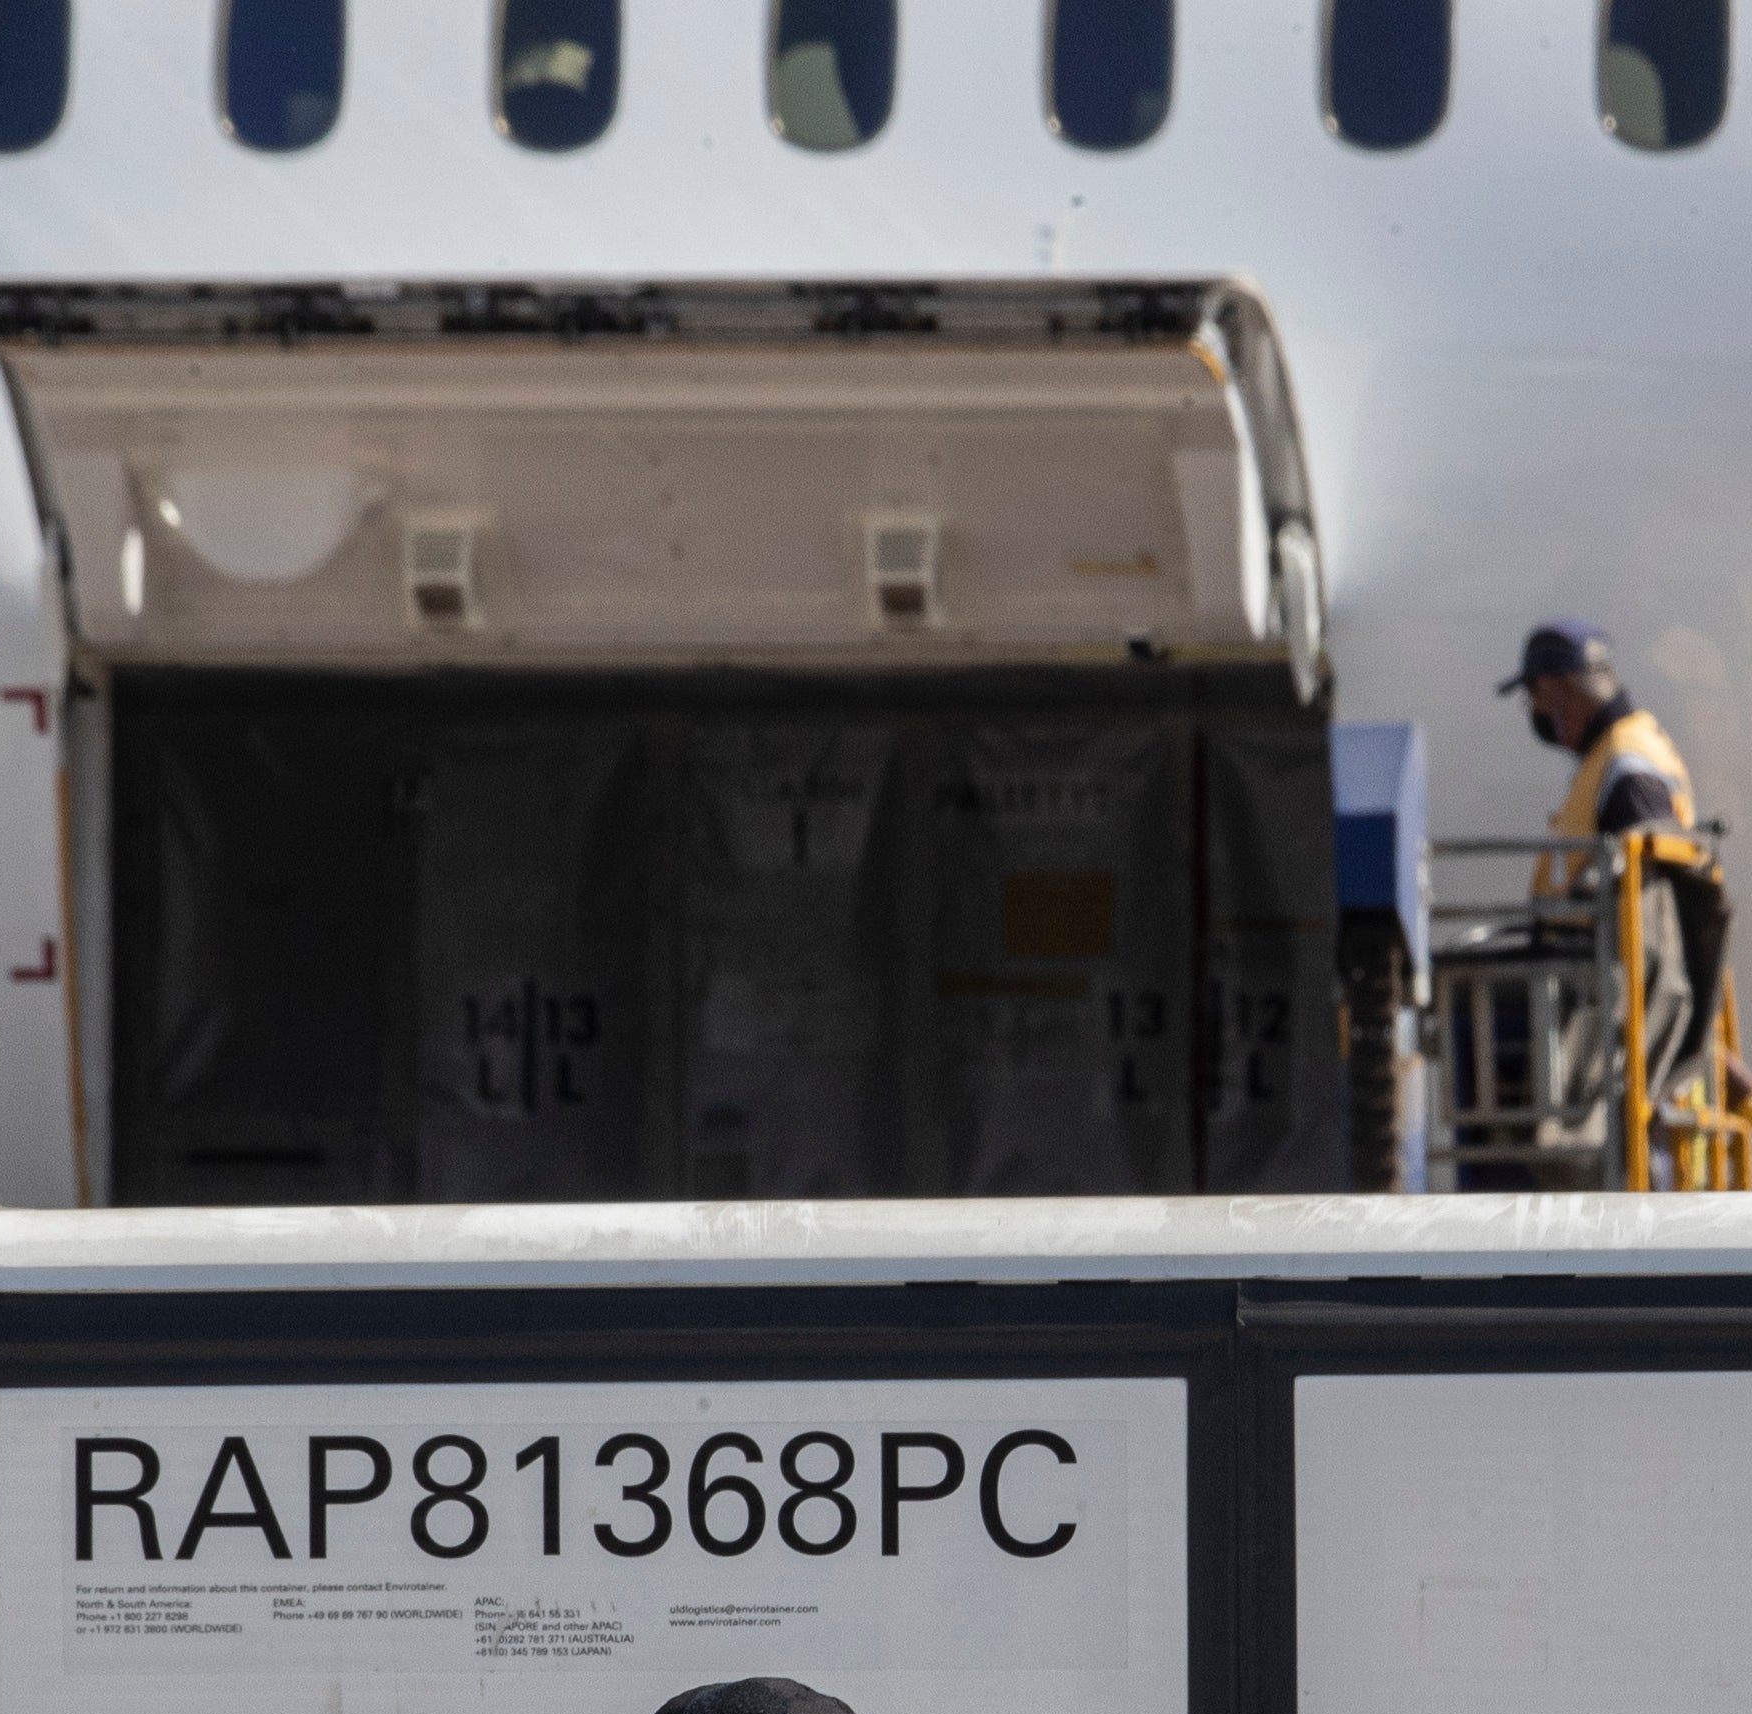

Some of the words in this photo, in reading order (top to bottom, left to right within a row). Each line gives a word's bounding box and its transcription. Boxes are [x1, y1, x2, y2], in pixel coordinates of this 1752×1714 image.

[543, 993, 602, 1046] 13
[1107, 990, 1166, 1040] 13
[72, 1429, 1078, 1562] RAP81368PC
[127, 1585, 146, 1593] and
[150, 1584, 206, 1594] information
[209, 1584, 237, 1593] about
[76, 1600, 103, 1609] North
[106, 1600, 115, 1609] &
[117, 1600, 146, 1609] South
[76, 1613, 107, 1621] Phone
[273, 1611, 304, 1620] Phone
[170, 1624, 242, 1634] (WORLDWIDE)
[475, 1622, 538, 1631] (SINAPORE
[542, 1622, 560, 1631] and
[563, 1622, 589, 1631] other
[568, 1634, 634, 1644] (AUSTRALIA)
